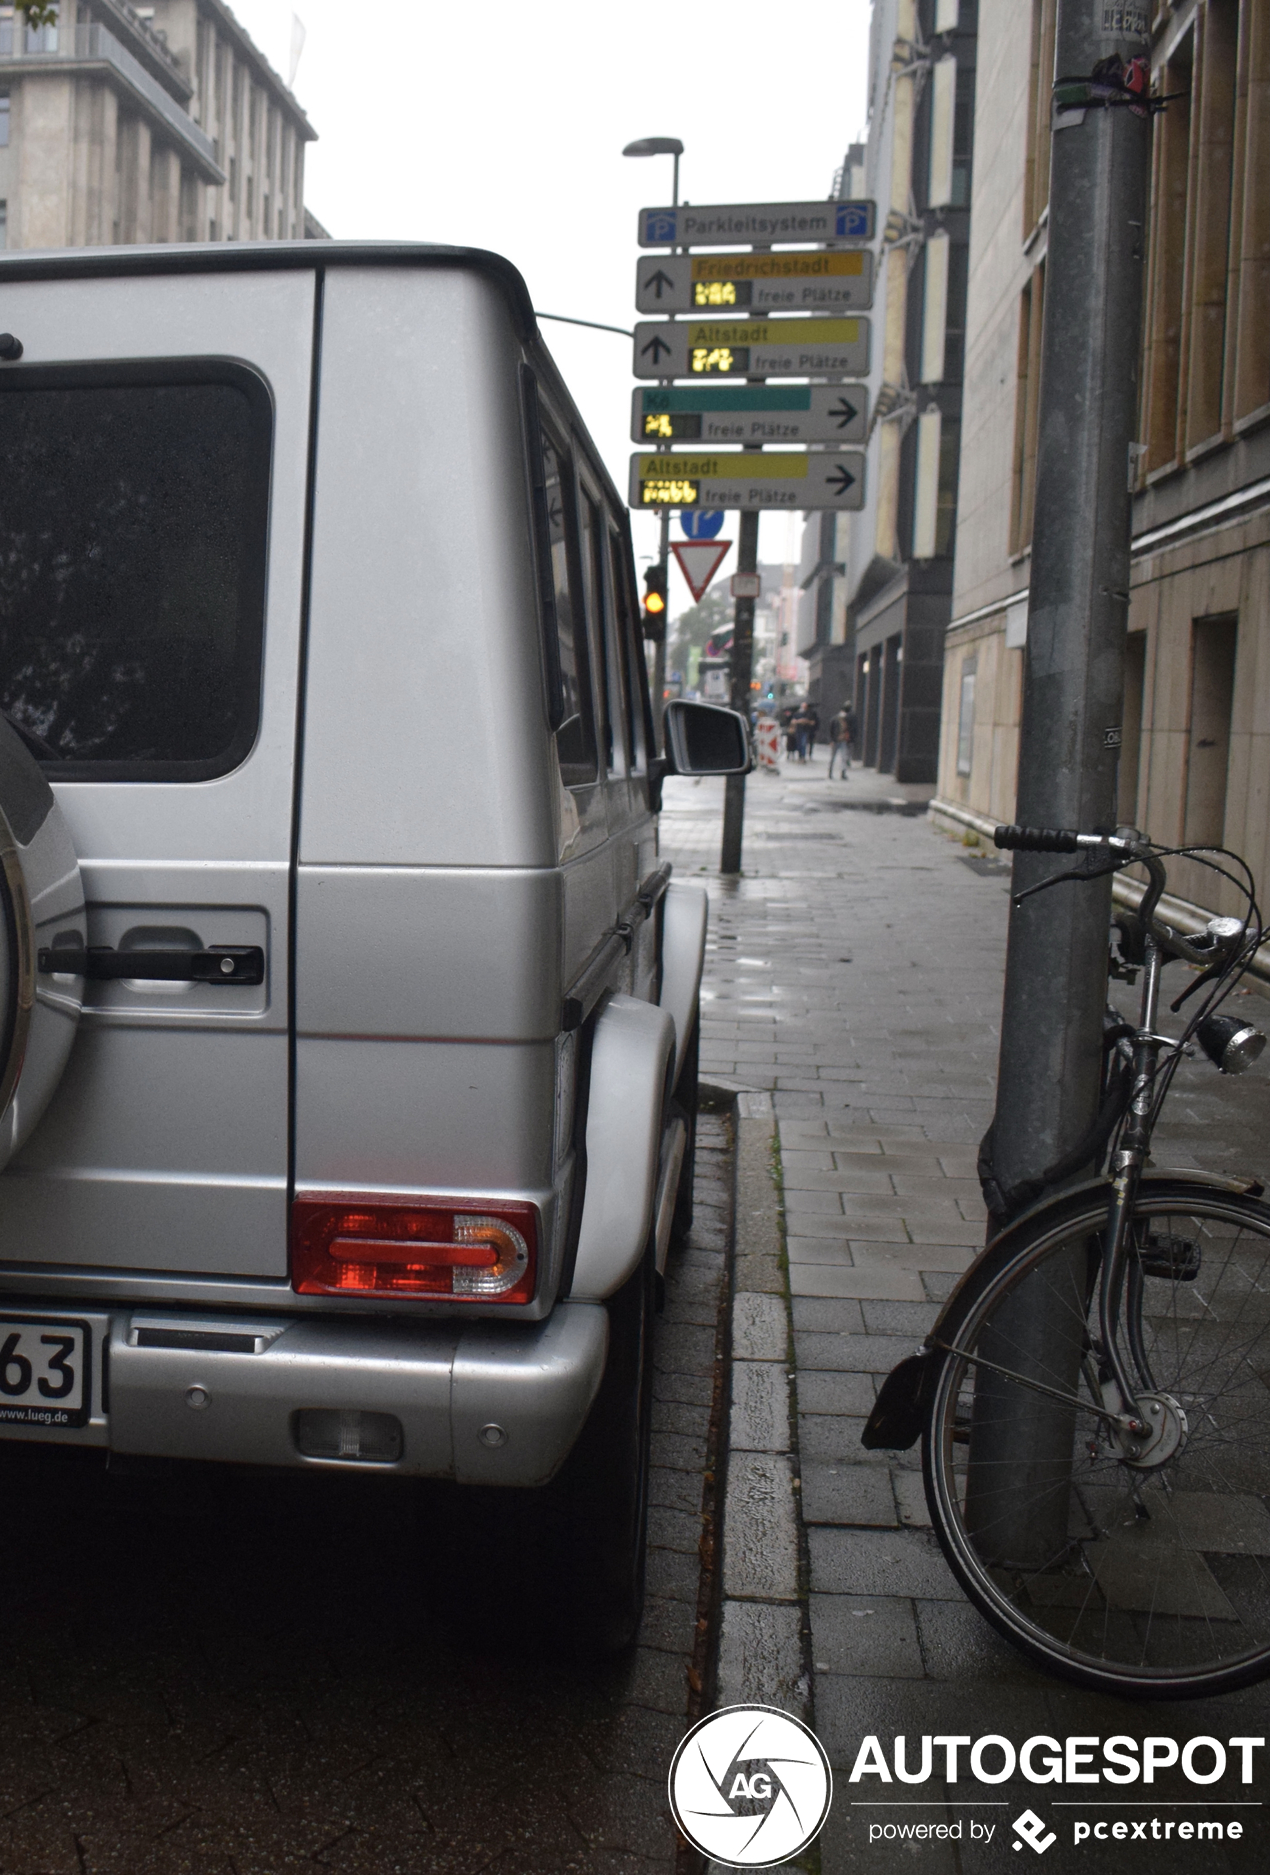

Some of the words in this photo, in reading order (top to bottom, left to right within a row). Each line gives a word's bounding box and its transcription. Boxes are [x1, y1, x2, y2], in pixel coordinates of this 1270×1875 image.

[654, 221, 669, 239] P
[683, 214, 827, 236] Parkleitsystem
[845, 214, 860, 235] P
[695, 257, 830, 277] Friedrichstadt
[757, 288, 795, 303] freie
[801, 286, 852, 303] Plätze
[694, 325, 768, 343] Altstadt
[754, 355, 792, 370] freie
[798, 353, 849, 370] Plätze
[707, 421, 744, 436] freie
[750, 420, 800, 437] Plätze
[645, 458, 719, 475] Altstadt
[705, 488, 742, 503] freie
[748, 487, 797, 503] Plätze
